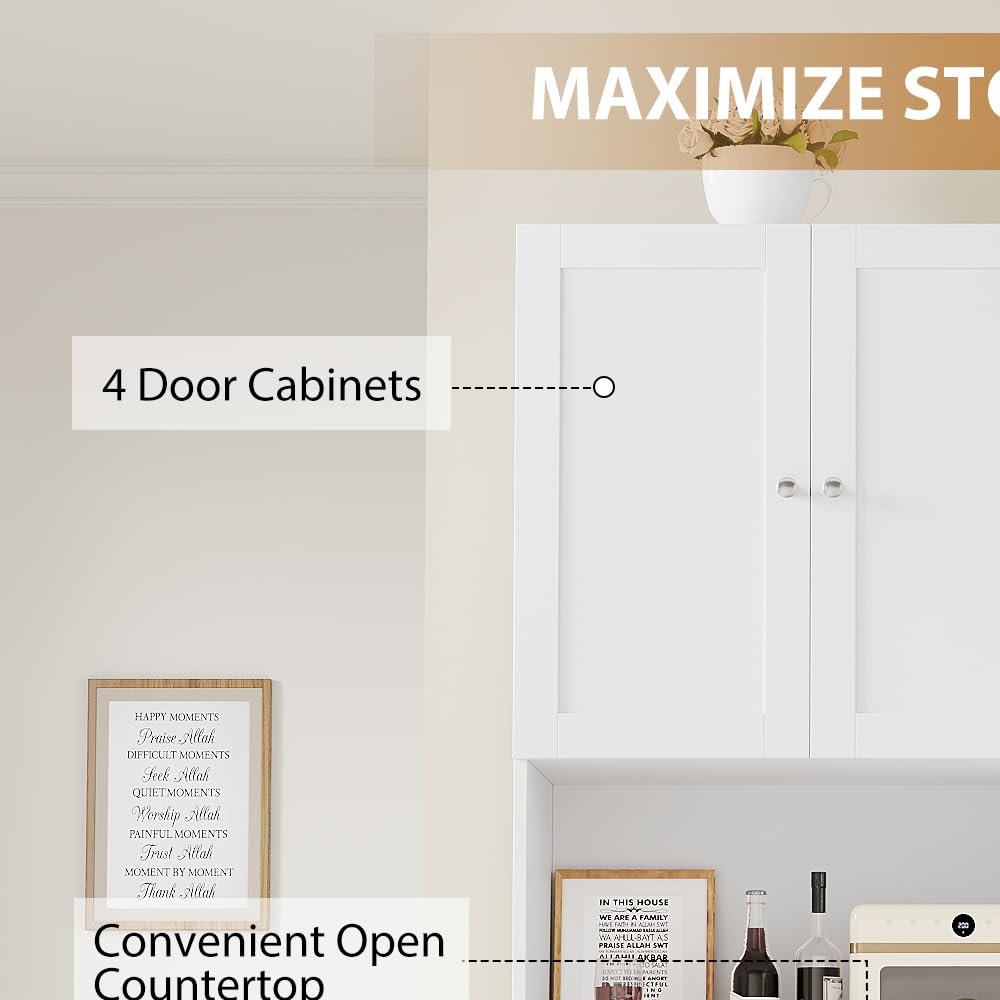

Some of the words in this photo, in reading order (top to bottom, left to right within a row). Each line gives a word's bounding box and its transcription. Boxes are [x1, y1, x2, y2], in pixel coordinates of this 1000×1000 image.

[135, 712, 166, 721] HAPPY
[170, 712, 219, 721] MOMENTS
[137, 727, 176, 745] Praise
[179, 727, 215, 744] Allah
[127, 750, 177, 760] DIFFICULT
[180, 750, 230, 760] MOMENTS
[142, 766, 170, 783] Seek
[174, 766, 210, 783] Allah
[132, 788, 166, 798] QUIET
[167, 788, 220, 797] MOMENTS
[132, 805, 181, 828] Worship
[185, 805, 221, 822] Allah
[129, 829, 173, 839] PAINFUL
[174, 829, 228, 839] MOMENTS
[140, 843, 173, 861] Trust
[177, 843, 213, 860] Allah
[124, 867, 170, 877] MOMENT
[173, 867, 186, 877] BY
[188, 867, 234, 877] MOMENT
[137, 882, 176, 899] Thank
[180, 882, 217, 899] Allah
[958, 921, 970, 929] 200
[638, 954, 668, 962] AKBAR
